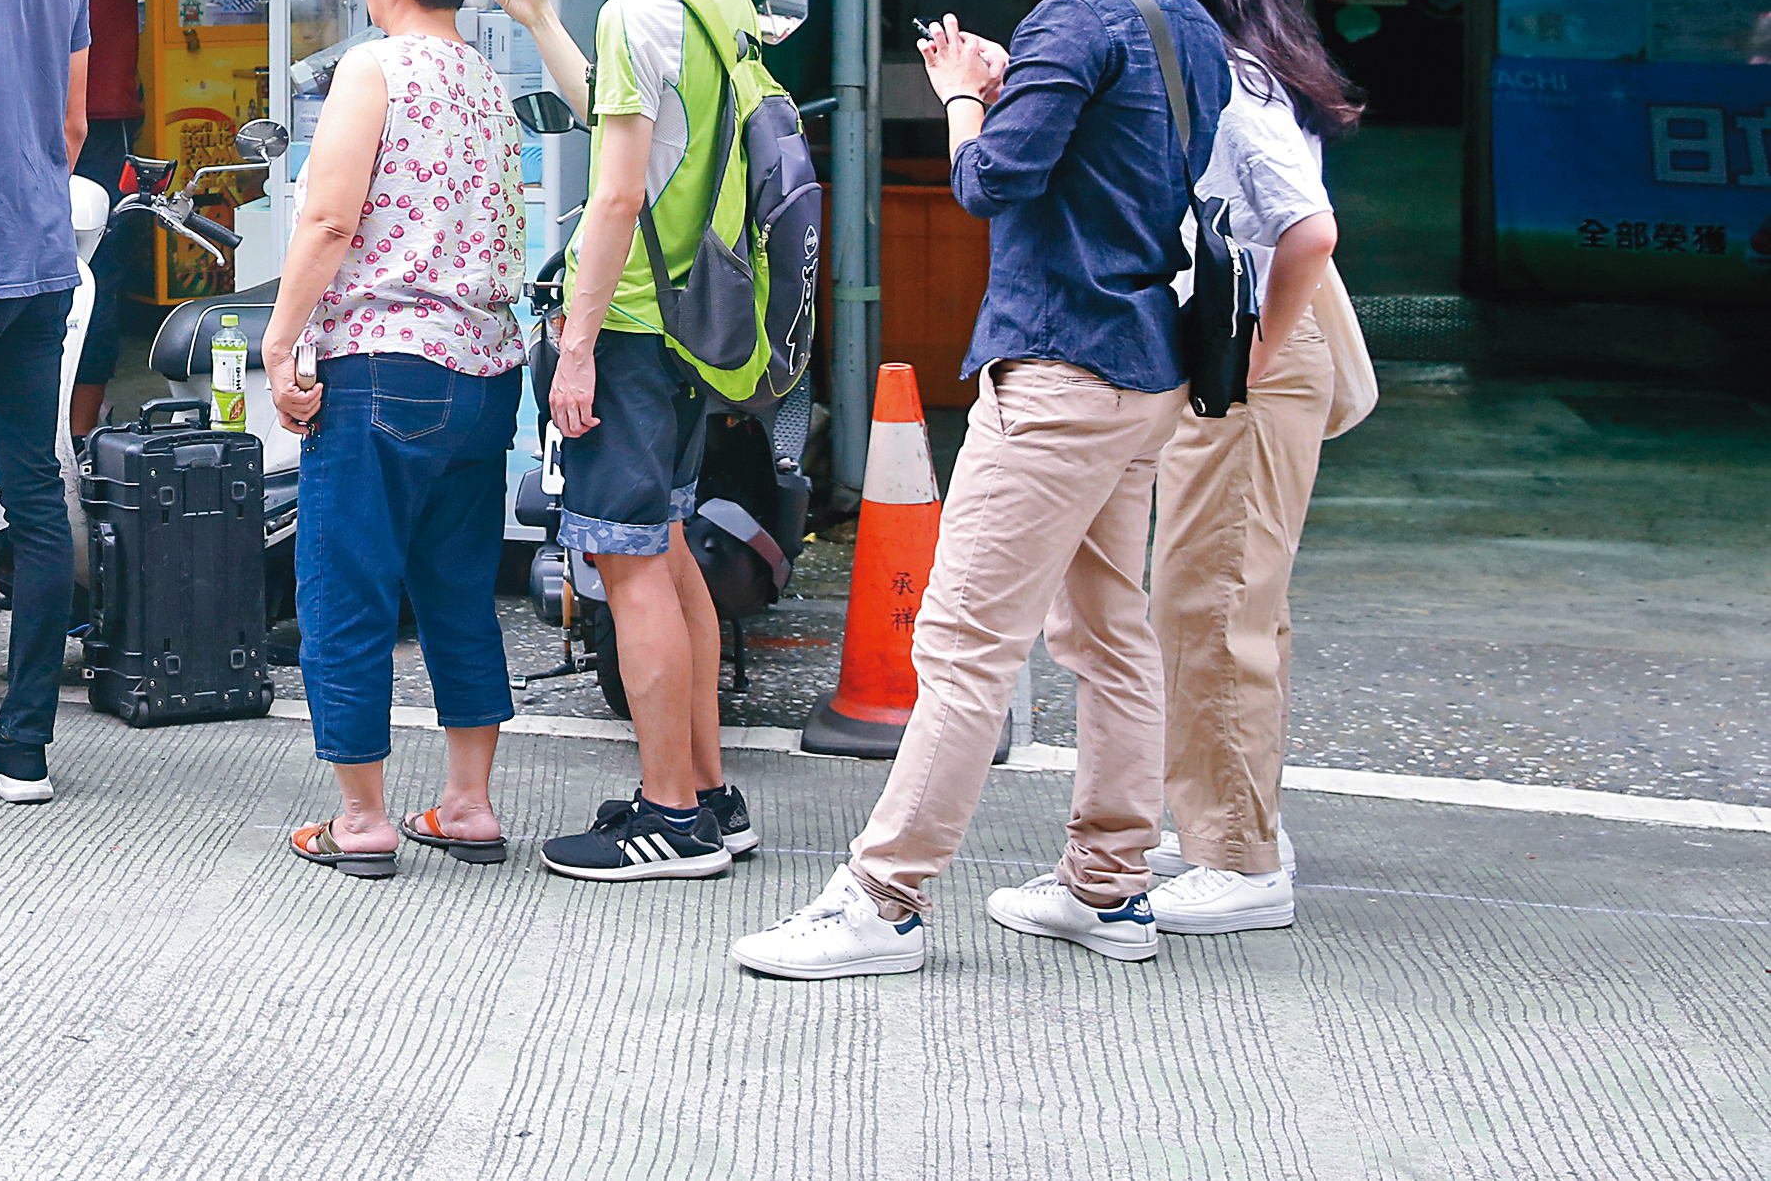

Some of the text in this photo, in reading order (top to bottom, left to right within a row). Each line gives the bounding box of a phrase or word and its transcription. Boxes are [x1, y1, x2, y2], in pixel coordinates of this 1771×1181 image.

[1579, 219, 1727, 256] 全部榮獲
[889, 571, 915, 632] 承祥
